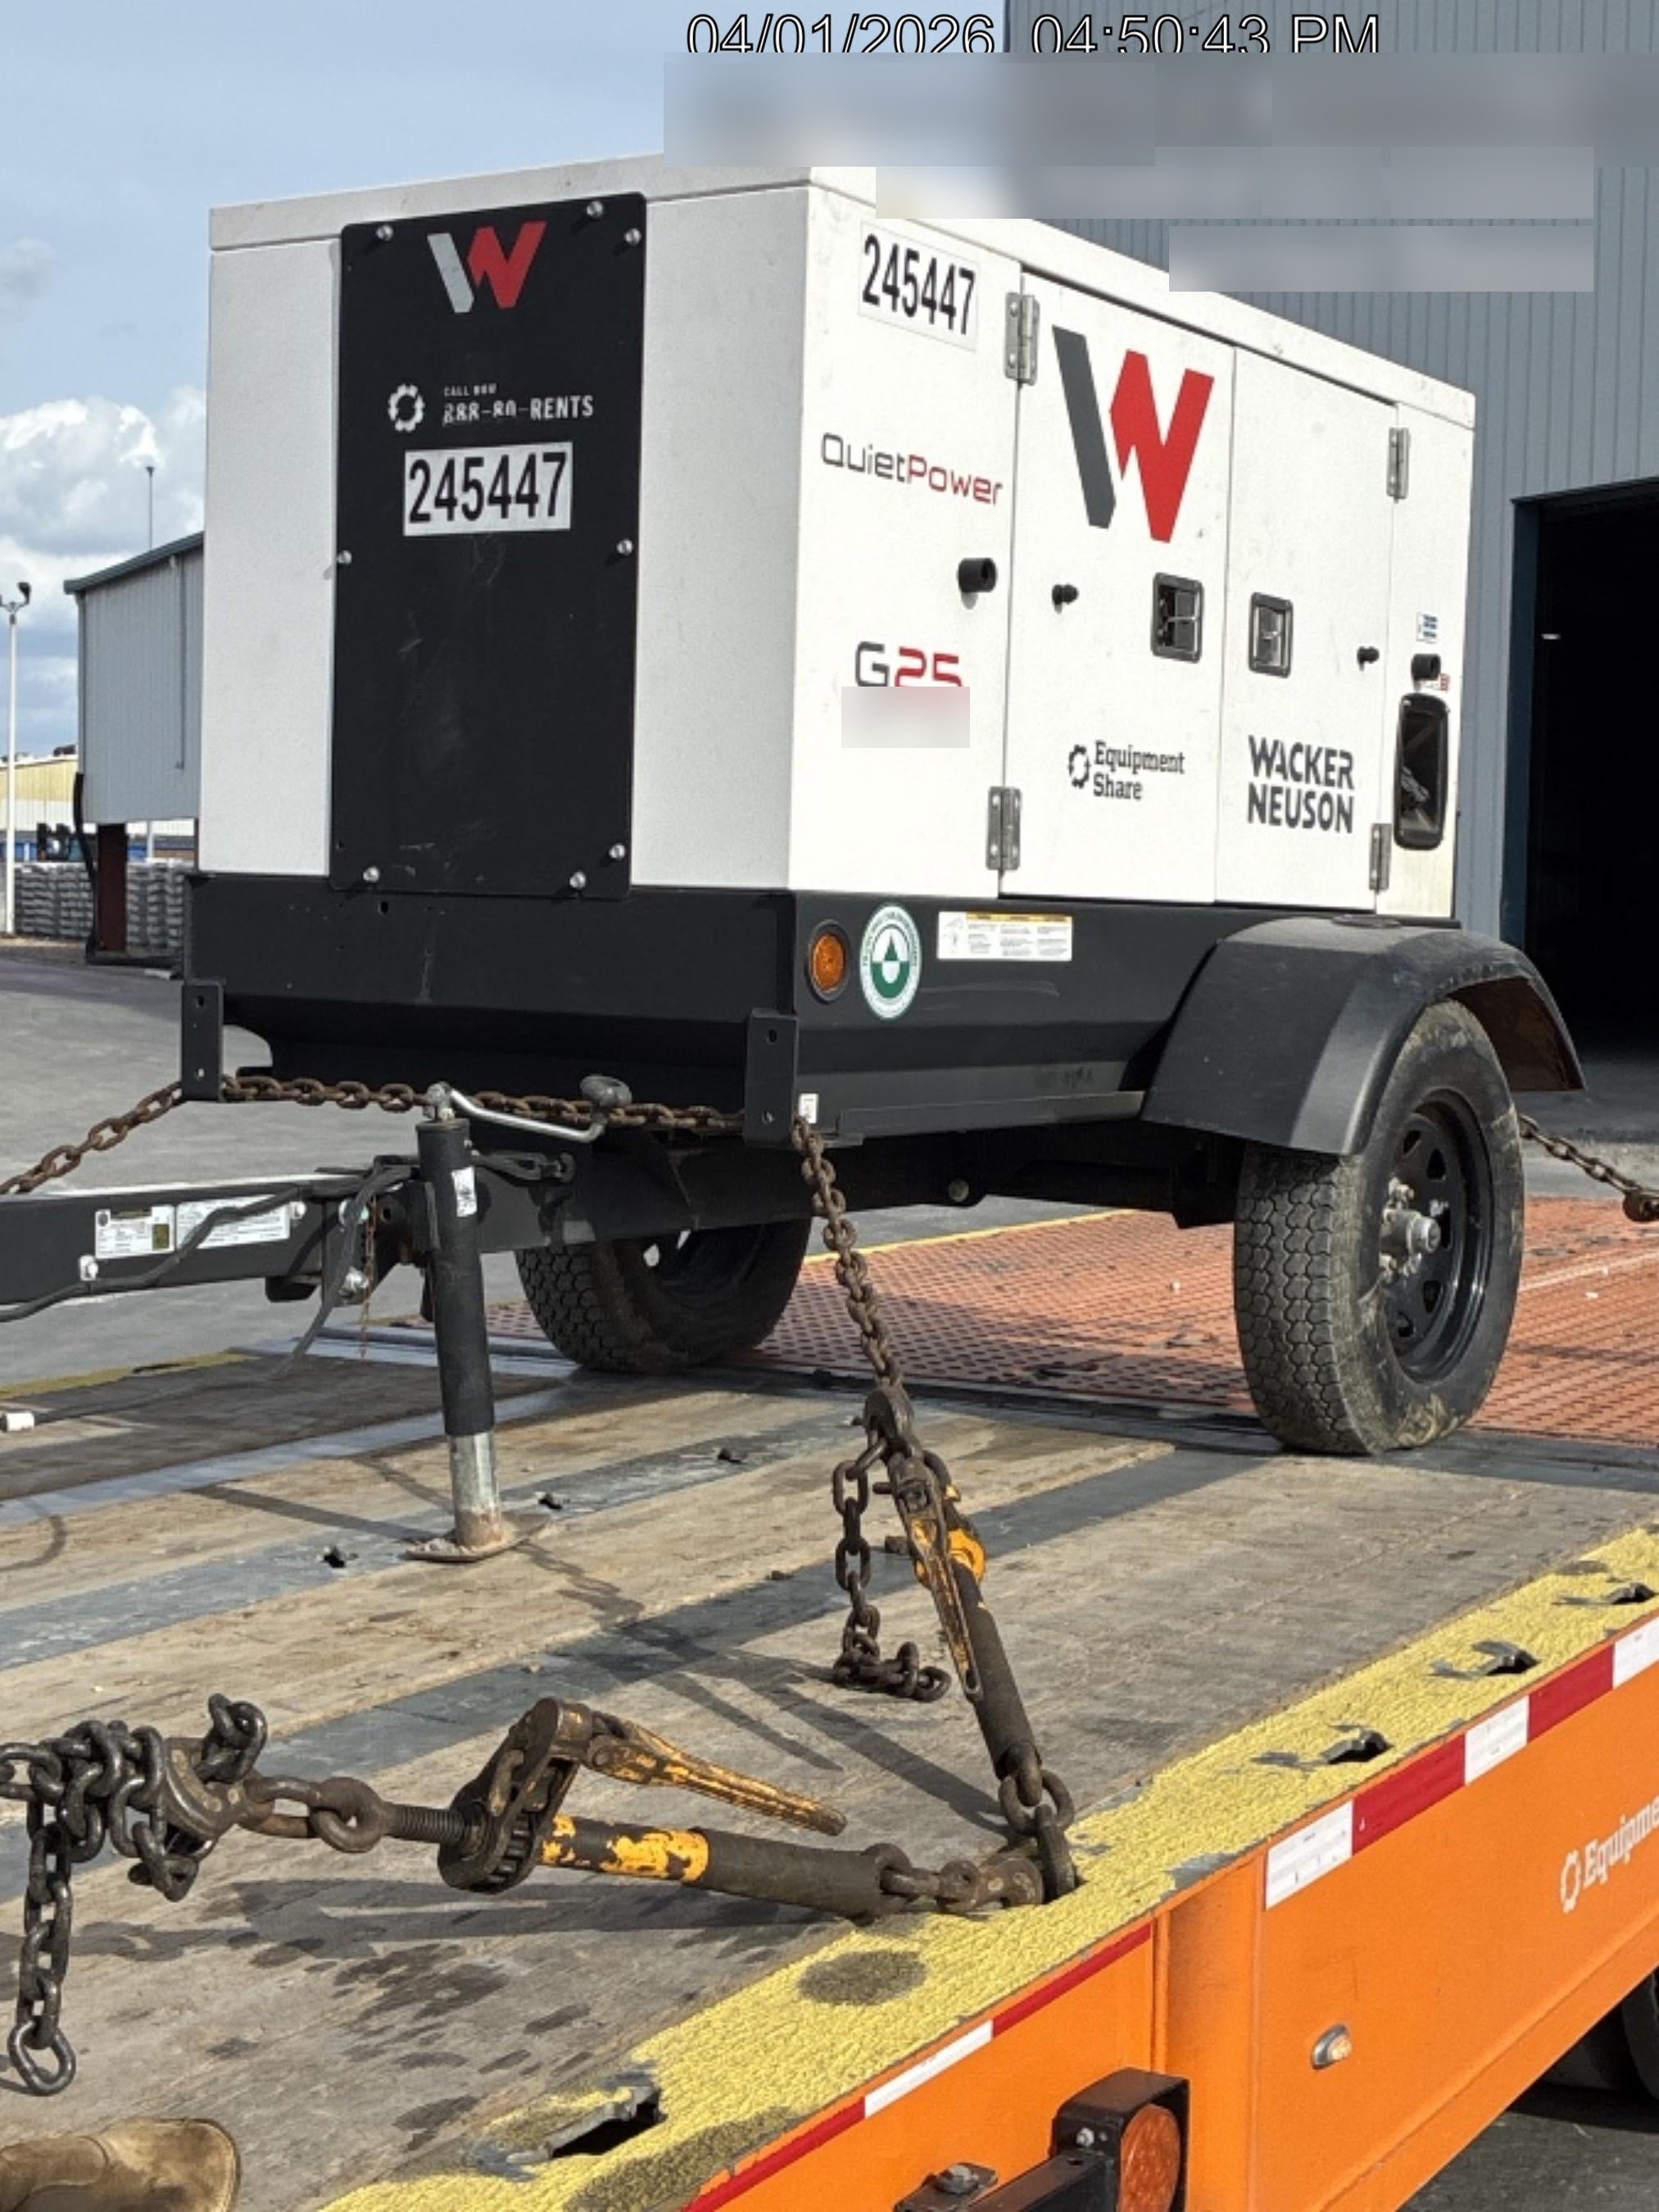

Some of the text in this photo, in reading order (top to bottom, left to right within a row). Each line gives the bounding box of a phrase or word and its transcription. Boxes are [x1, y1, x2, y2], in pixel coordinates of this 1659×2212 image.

[862, 233, 975, 335] 245447
[409, 451, 567, 524] 245447
[821, 433, 1002, 505] QuietPower
[854, 641, 963, 687] G25
[1095, 740, 1185, 774] Equipment
[1248, 734, 1354, 790] WACKER
[1094, 772, 1142, 800] Share
[1248, 782, 1353, 834] NEUSON
